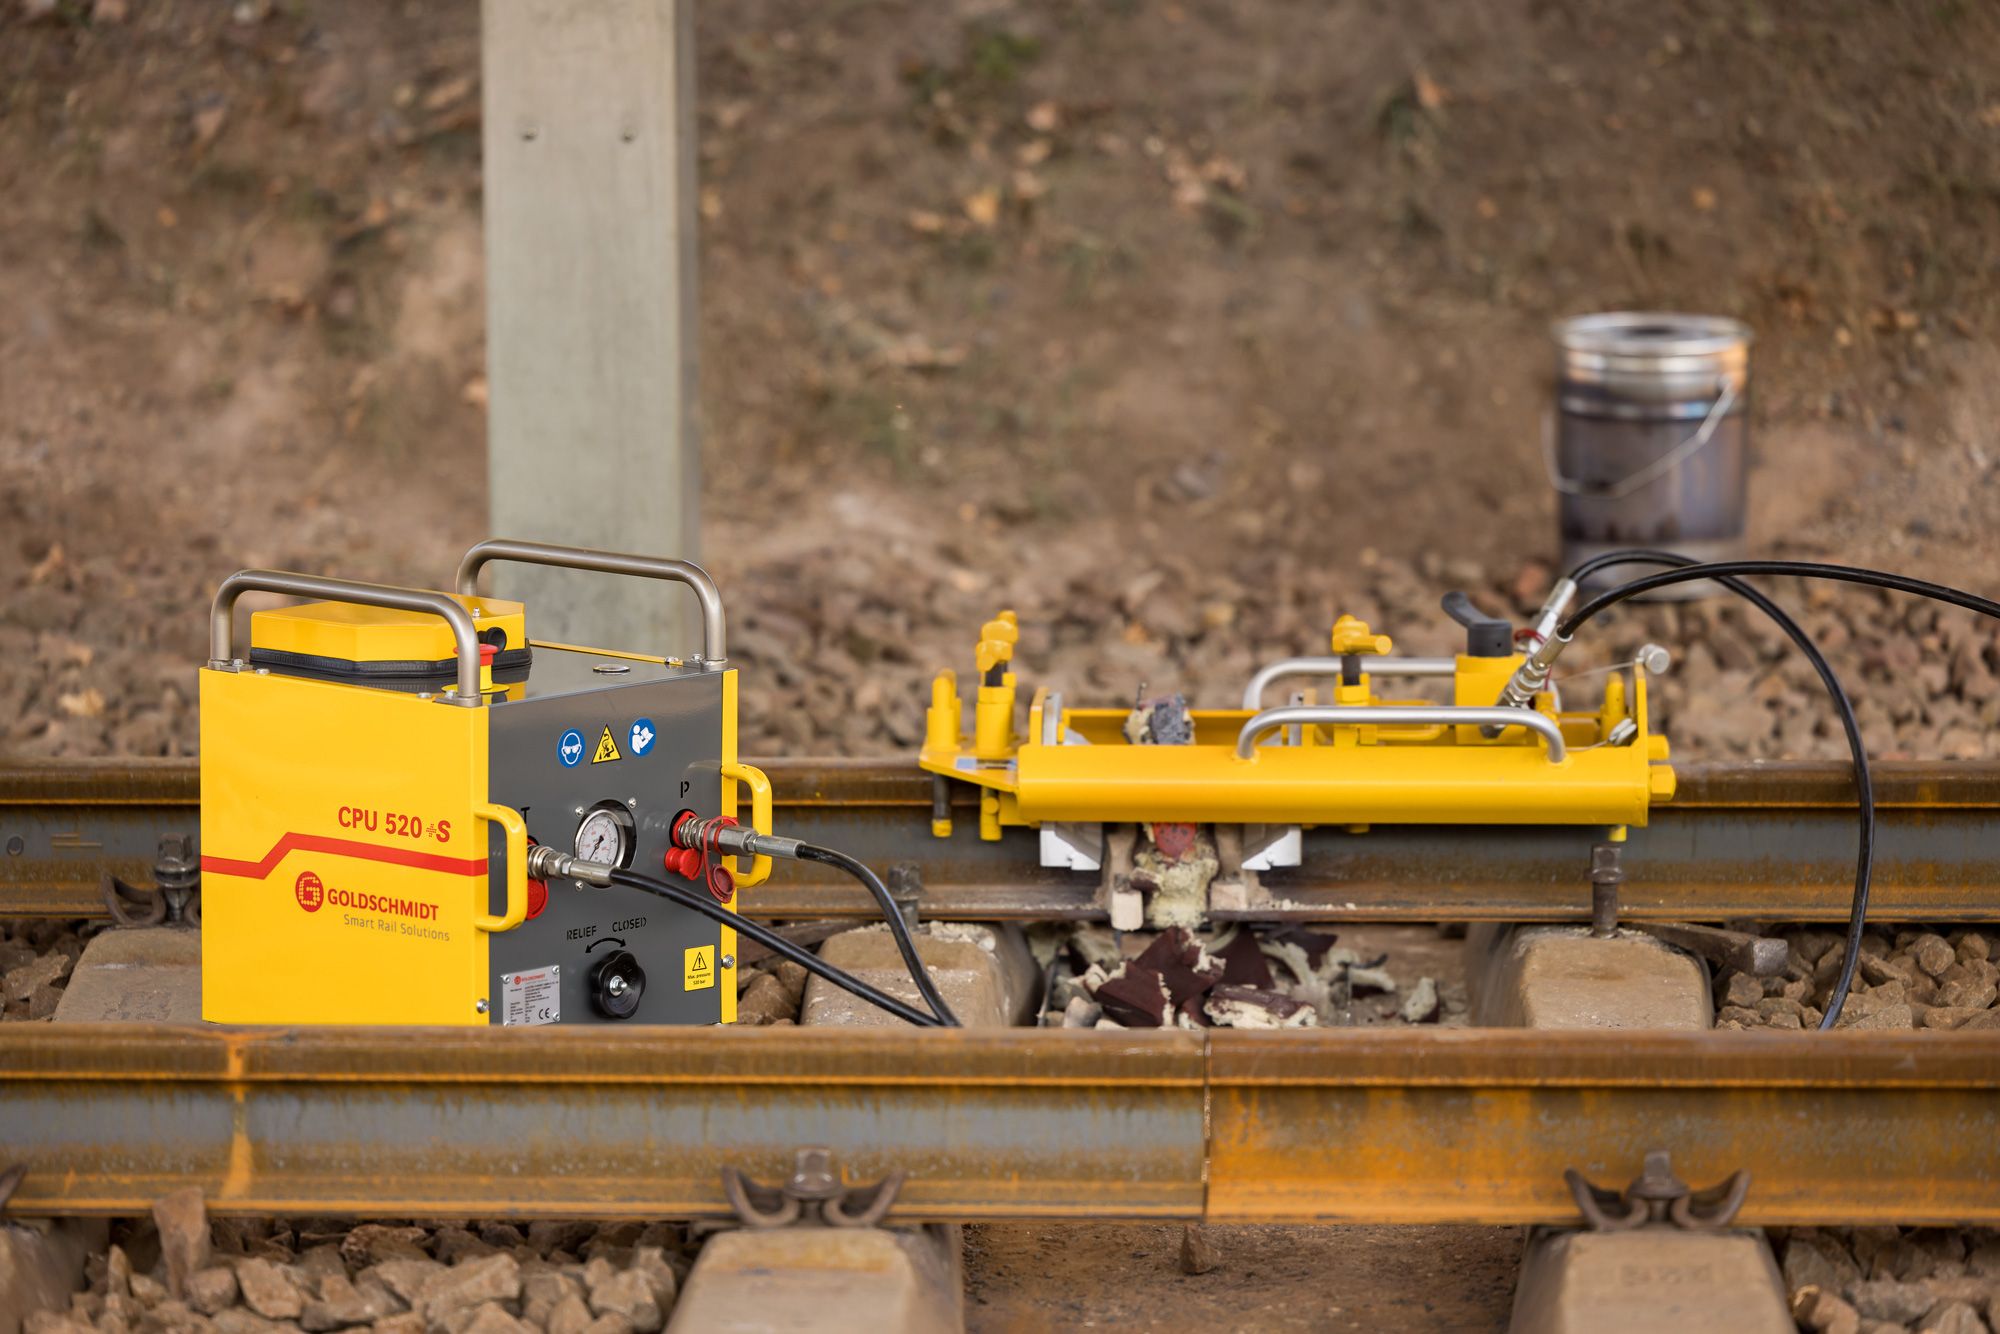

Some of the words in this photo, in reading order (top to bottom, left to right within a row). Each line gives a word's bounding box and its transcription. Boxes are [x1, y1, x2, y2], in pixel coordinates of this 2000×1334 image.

[680, 781, 690, 798] P
[338, 806, 378, 832] CPU
[520, 806, 531, 824] T
[327, 888, 439, 921] GOLDSCHMIDT
[343, 914, 375, 930] Smart
[378, 919, 397, 933] Rail
[400, 923, 450, 942] Solutions
[566, 926, 597, 941] RELIEF
[612, 917, 647, 933] CLOSED
[538, 1007, 550, 1020] CE
